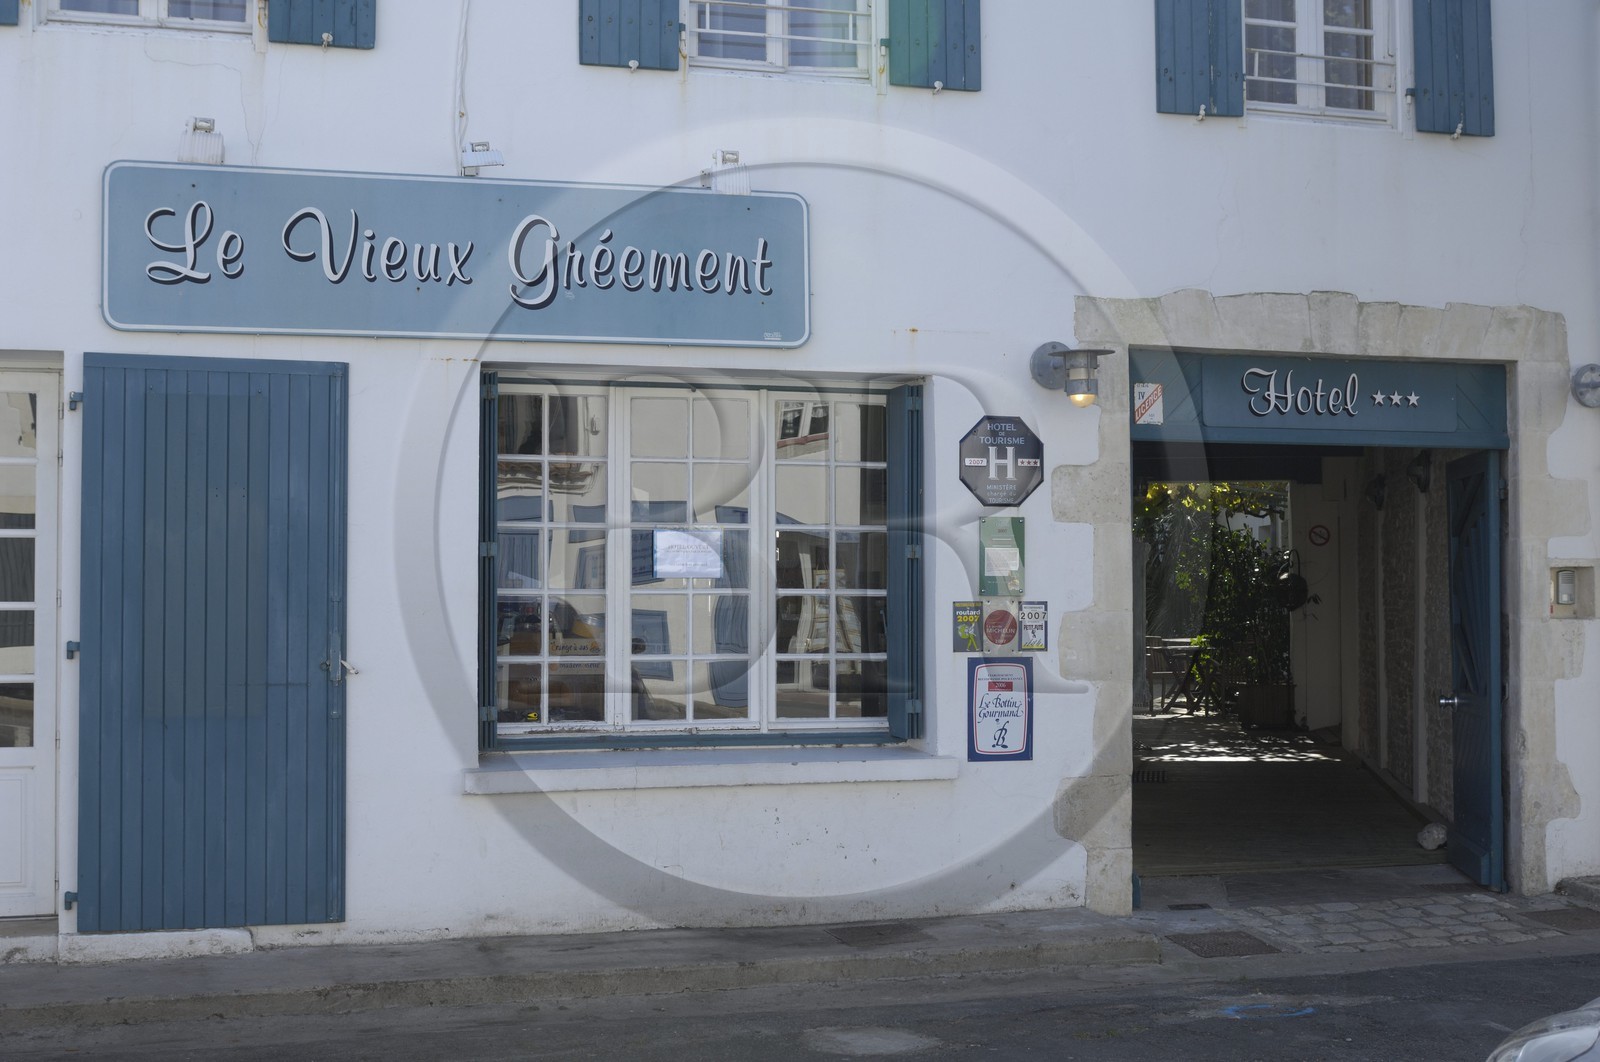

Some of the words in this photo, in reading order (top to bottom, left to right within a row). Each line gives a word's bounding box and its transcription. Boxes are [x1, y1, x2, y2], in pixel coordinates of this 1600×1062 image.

[144, 200, 245, 285] Le
[282, 206, 474, 286] Vieux
[508, 214, 773, 310] Gréement
[1138, 391, 1146, 400] IV
[1241, 368, 1359, 417] Hotel
[1135, 384, 1163, 423] LICENCE
[987, 423, 1017, 431] HOTEL
[979, 436, 1025, 445] TOURISME
[988, 446, 1017, 480] H
[1020, 611, 1047, 620] 2007
[979, 693, 991, 709] Le
[992, 694, 1023, 709] Bottin
[977, 708, 1024, 724] Gourmand
